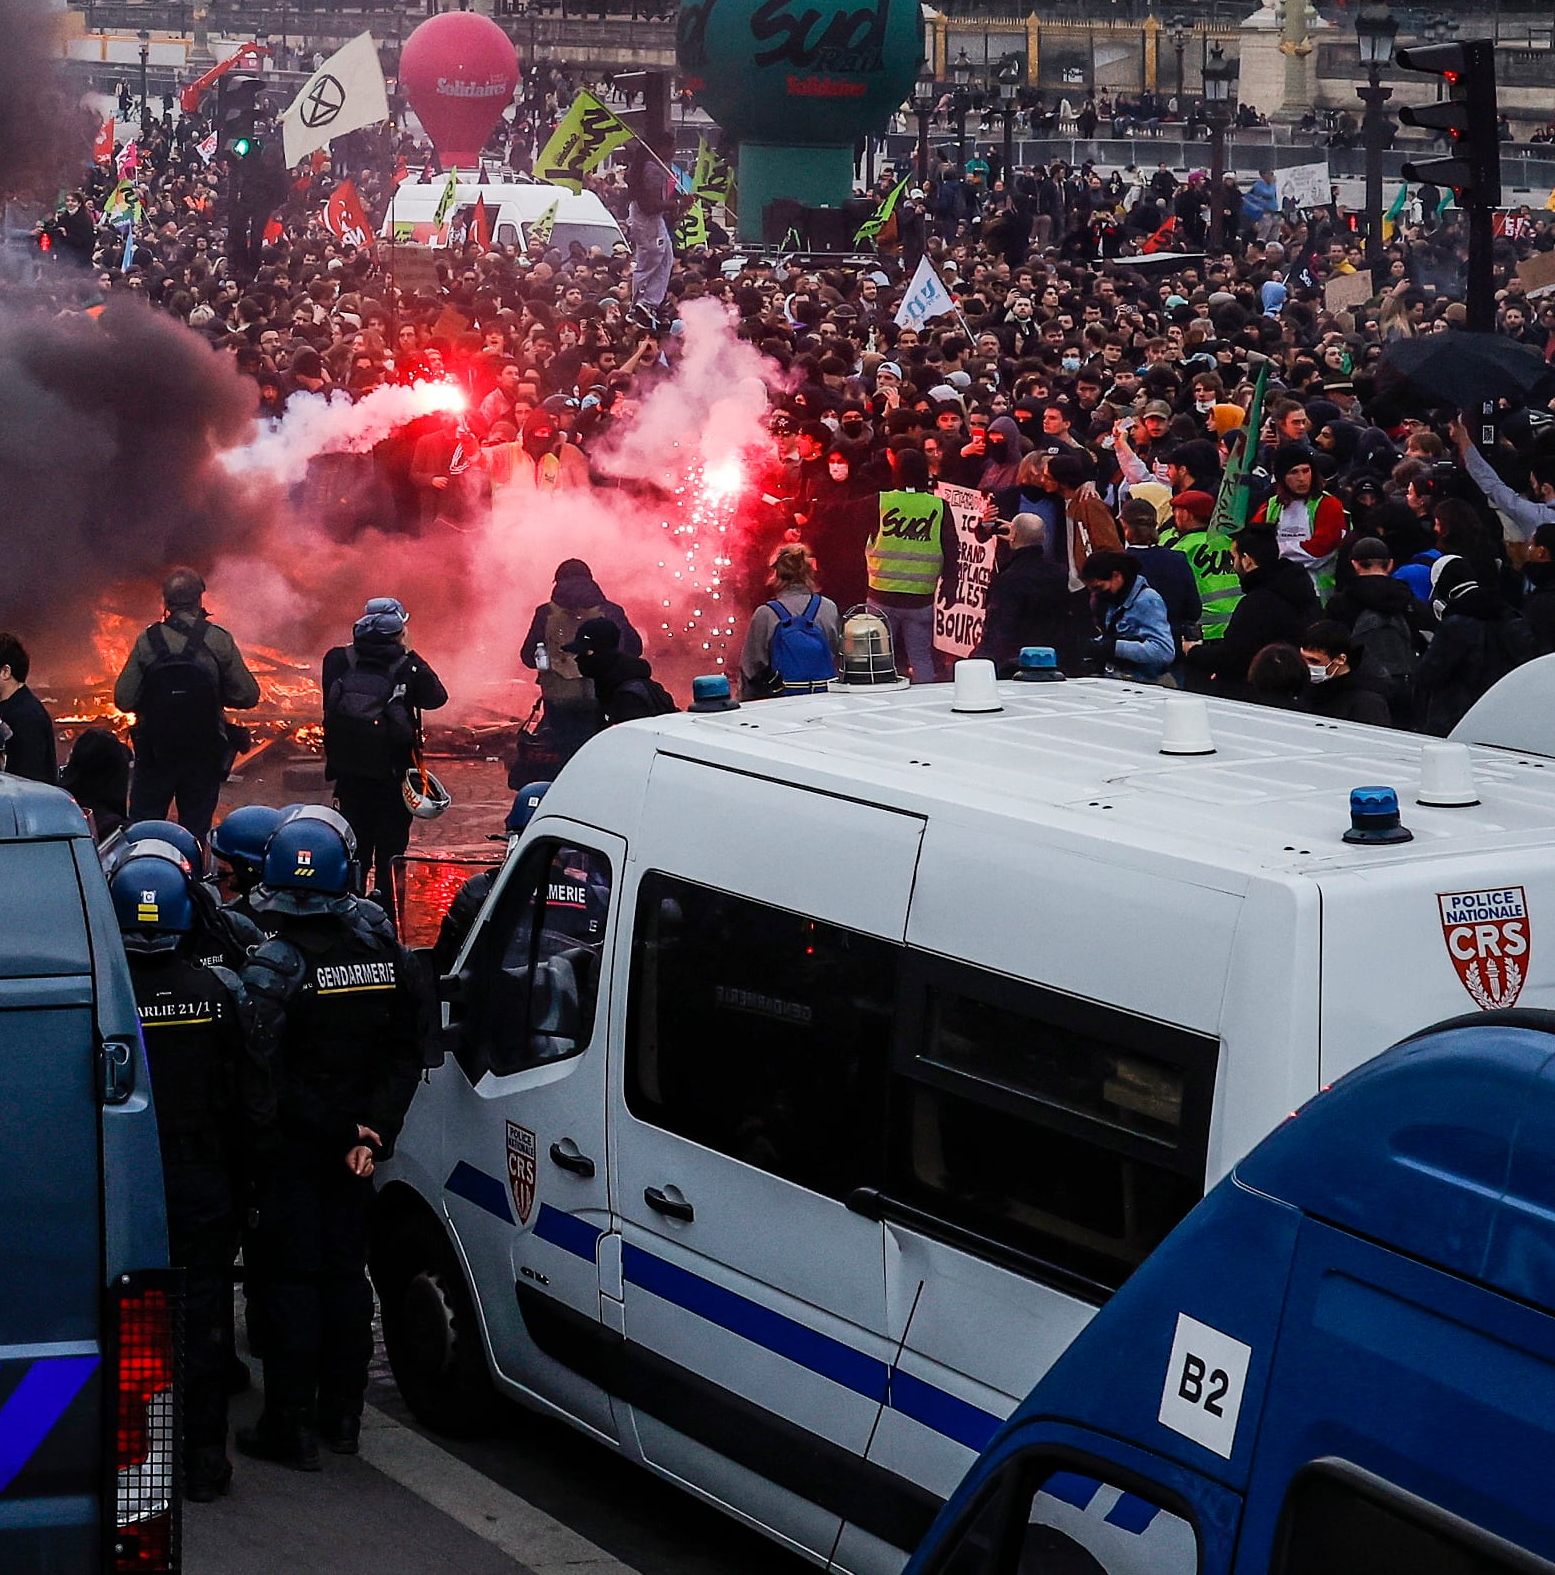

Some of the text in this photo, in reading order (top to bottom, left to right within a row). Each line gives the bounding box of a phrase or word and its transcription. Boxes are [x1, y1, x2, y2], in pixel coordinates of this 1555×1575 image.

[436, 76, 507, 98] Solidaires
[882, 507, 938, 541] Sud
[958, 541, 986, 564] RAND
[1452, 891, 1515, 909] POLICE
[1446, 904, 1523, 924] NATIONALE
[1448, 921, 1527, 961] CRS
[317, 962, 396, 989] GENDARMERIE
[137, 1000, 211, 1018] ARLIE 21/1
[509, 1126, 532, 1145] POLICE
[508, 1153, 534, 1185] CRS
[1177, 1352, 1230, 1418] B2
